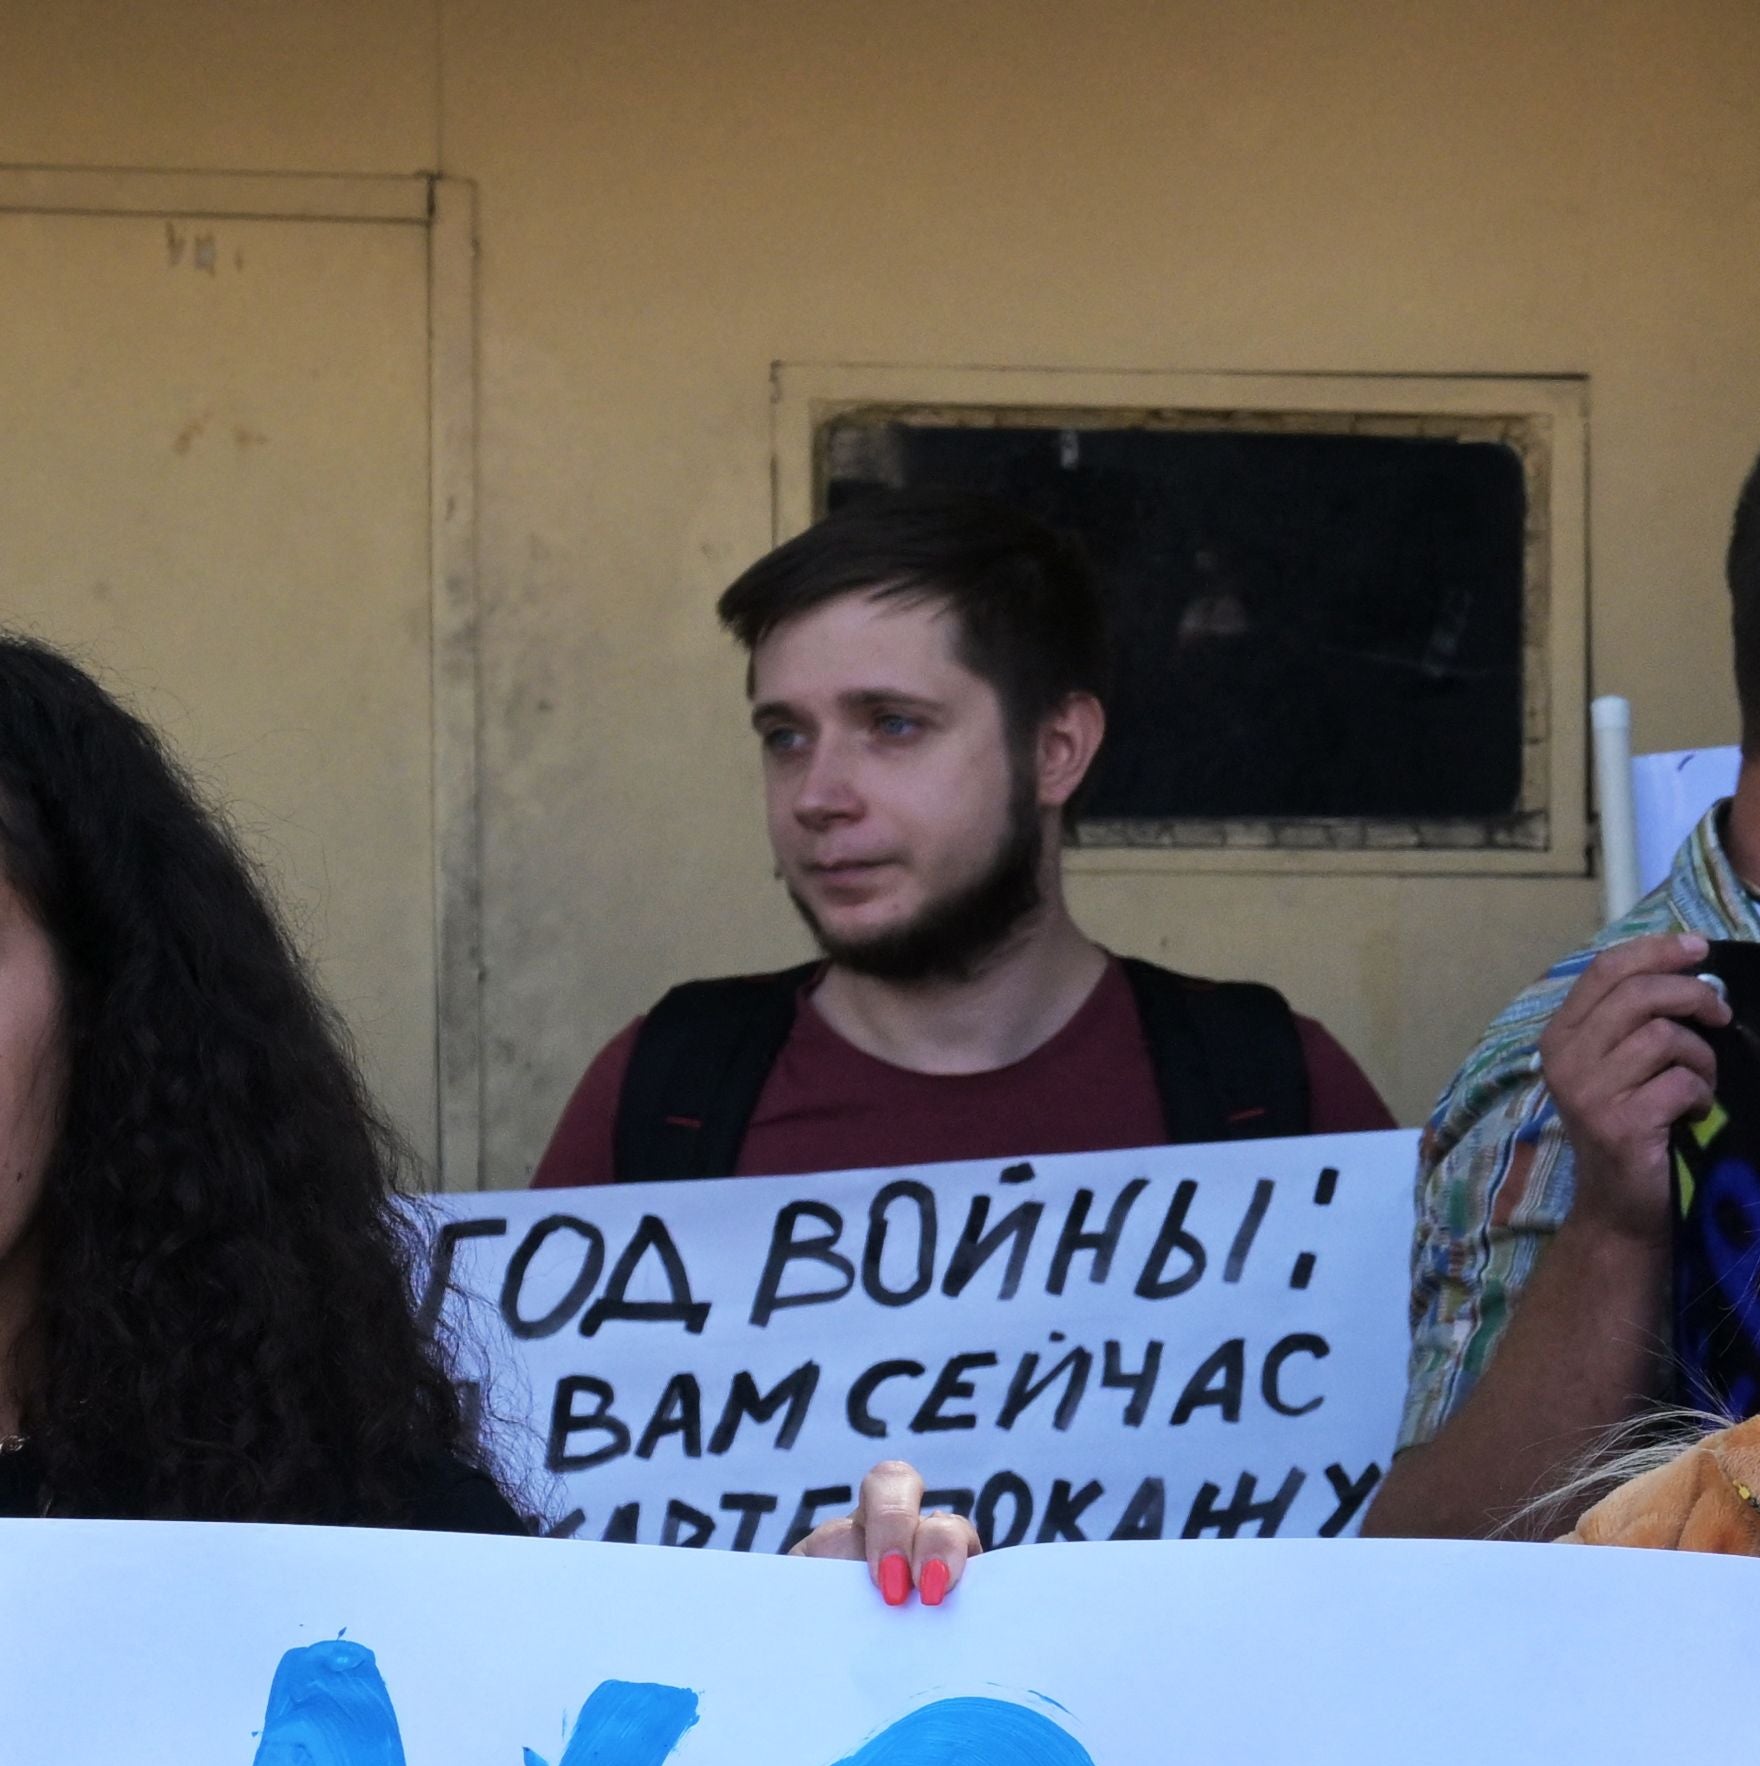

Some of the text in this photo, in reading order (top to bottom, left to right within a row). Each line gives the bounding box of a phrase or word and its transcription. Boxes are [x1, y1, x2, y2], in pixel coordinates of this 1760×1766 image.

[418, 1162, 1339, 1341] ГОД ВОЙНЫ:
[545, 1360, 821, 1473] ВАМ
[846, 1331, 1331, 1438] СЕЙЧАС
